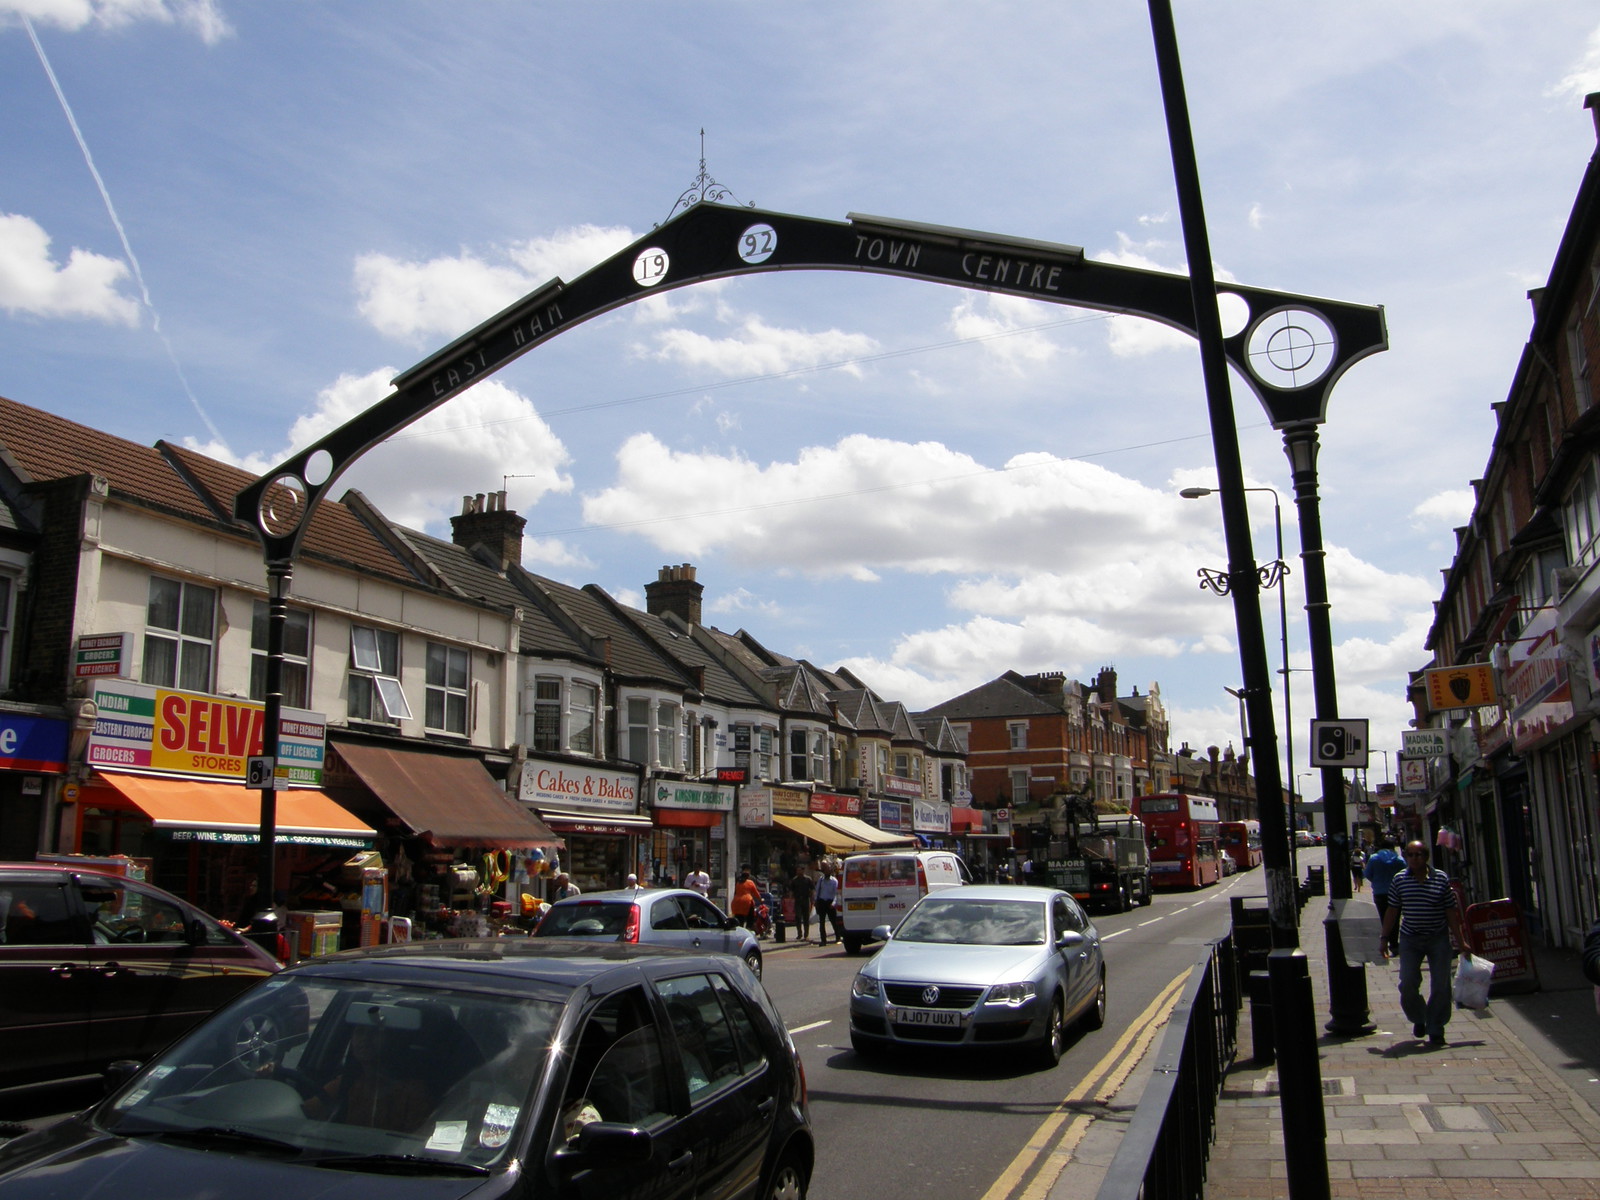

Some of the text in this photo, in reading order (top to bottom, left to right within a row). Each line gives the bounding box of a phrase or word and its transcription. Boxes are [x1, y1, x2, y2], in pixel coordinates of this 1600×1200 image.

[642, 231, 772, 279] 19 92
[855, 235, 1064, 291] TOWN CENTRE
[431, 302, 564, 397] EAST HAM
[84, 650, 115, 661] GROCERS
[80, 664, 117, 675] OFF LICENCE
[98, 694, 129, 711] INDIAN
[96, 721, 154, 741] EASTERN EUROPEAN
[282, 722, 324, 738] MONEY EXCHANGE
[1405, 734, 1433, 745] MADINA
[93, 746, 135, 763] GROCERS
[280, 744, 319, 759] OFF LICENCE
[1407, 745, 1444, 756] MASJID
[191, 754, 242, 772] STORES
[288, 768, 316, 781] GETABLE
[718, 770, 745, 781] CHEMIST
[537, 769, 635, 800] Cakes & Bakes
[172, 831, 193, 841] BEER
[196, 831, 217, 841] WINE
[222, 833, 248, 842] SPIRITS
[293, 836, 325, 845] GROCERY
[331, 837, 366, 847] VEGETABLES
[1047, 860, 1086, 868] MAJORS
[1484, 927, 1509, 939] ESTATE
[1481, 938, 1509, 951] LETTING
[901, 1011, 955, 1025] AJ07 UUX
